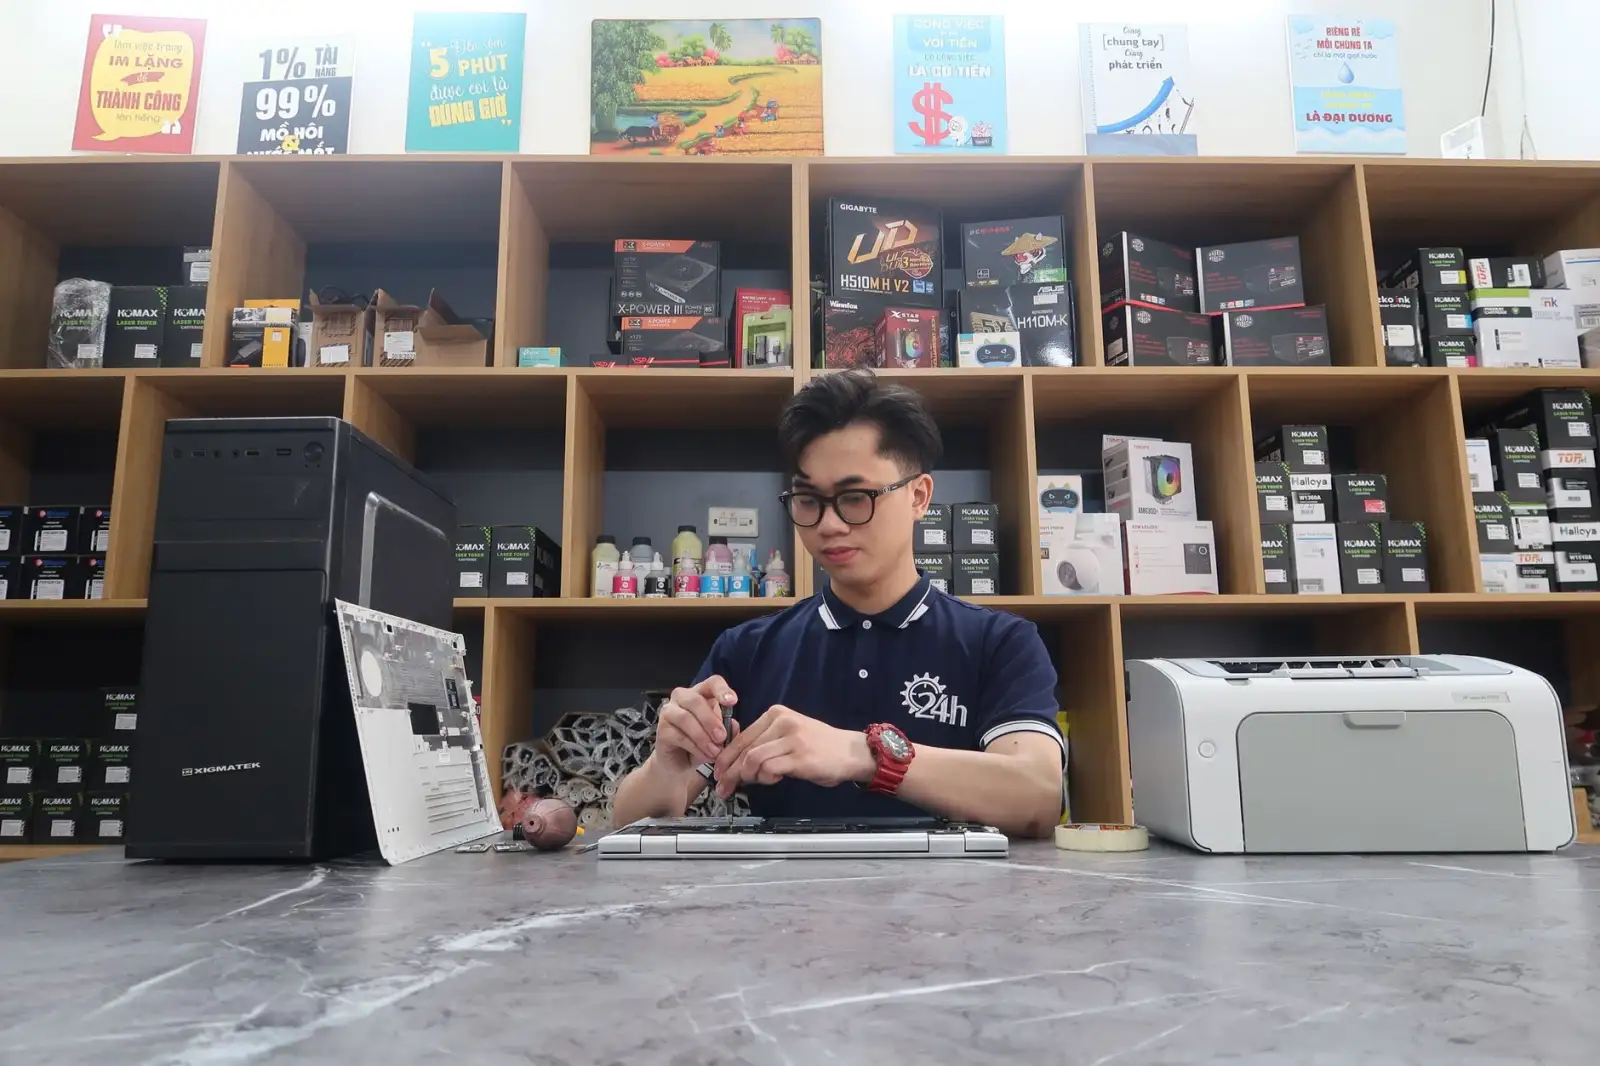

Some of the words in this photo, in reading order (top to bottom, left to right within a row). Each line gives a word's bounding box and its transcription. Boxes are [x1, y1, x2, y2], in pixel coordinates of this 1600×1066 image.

[1363, 41, 1373, 50] TA
[108, 55, 129, 67] IM
[134, 53, 184, 70] LẶNG
[259, 46, 306, 80] 1%
[315, 43, 339, 65] TÀI
[429, 47, 450, 79] 5
[458, 52, 508, 77] PHÚT
[1109, 59, 1133, 71] phát
[1136, 56, 1163, 69] triển
[96, 87, 141, 110] THÀNH
[144, 90, 182, 111] CÔNG
[255, 84, 336, 120] 99%
[1306, 110, 1321, 122] LÀ
[1322, 112, 1345, 124] ĐẠI
[1349, 111, 1393, 123] DƯƠNG
[294, 122, 324, 140] HÔI
[840, 203, 878, 214] GIGABYTE
[894, 279, 910, 293] V2
[1037, 285, 1064, 293] ASUS
[117, 309, 158, 317] KOMAX
[174, 308, 205, 317] KOMA
[617, 304, 670, 315] X-POWER
[673, 304, 683, 315] III
[1017, 314, 1068, 329] H110M-K
[1292, 476, 1327, 488] Halloya
[1560, 526, 1597, 537] Halloya
[456, 543, 484, 551] OMAX
[1388, 539, 1421, 547] KOMAX
[915, 692, 968, 727] 24h
[194, 762, 261, 775] XIGMATEK
